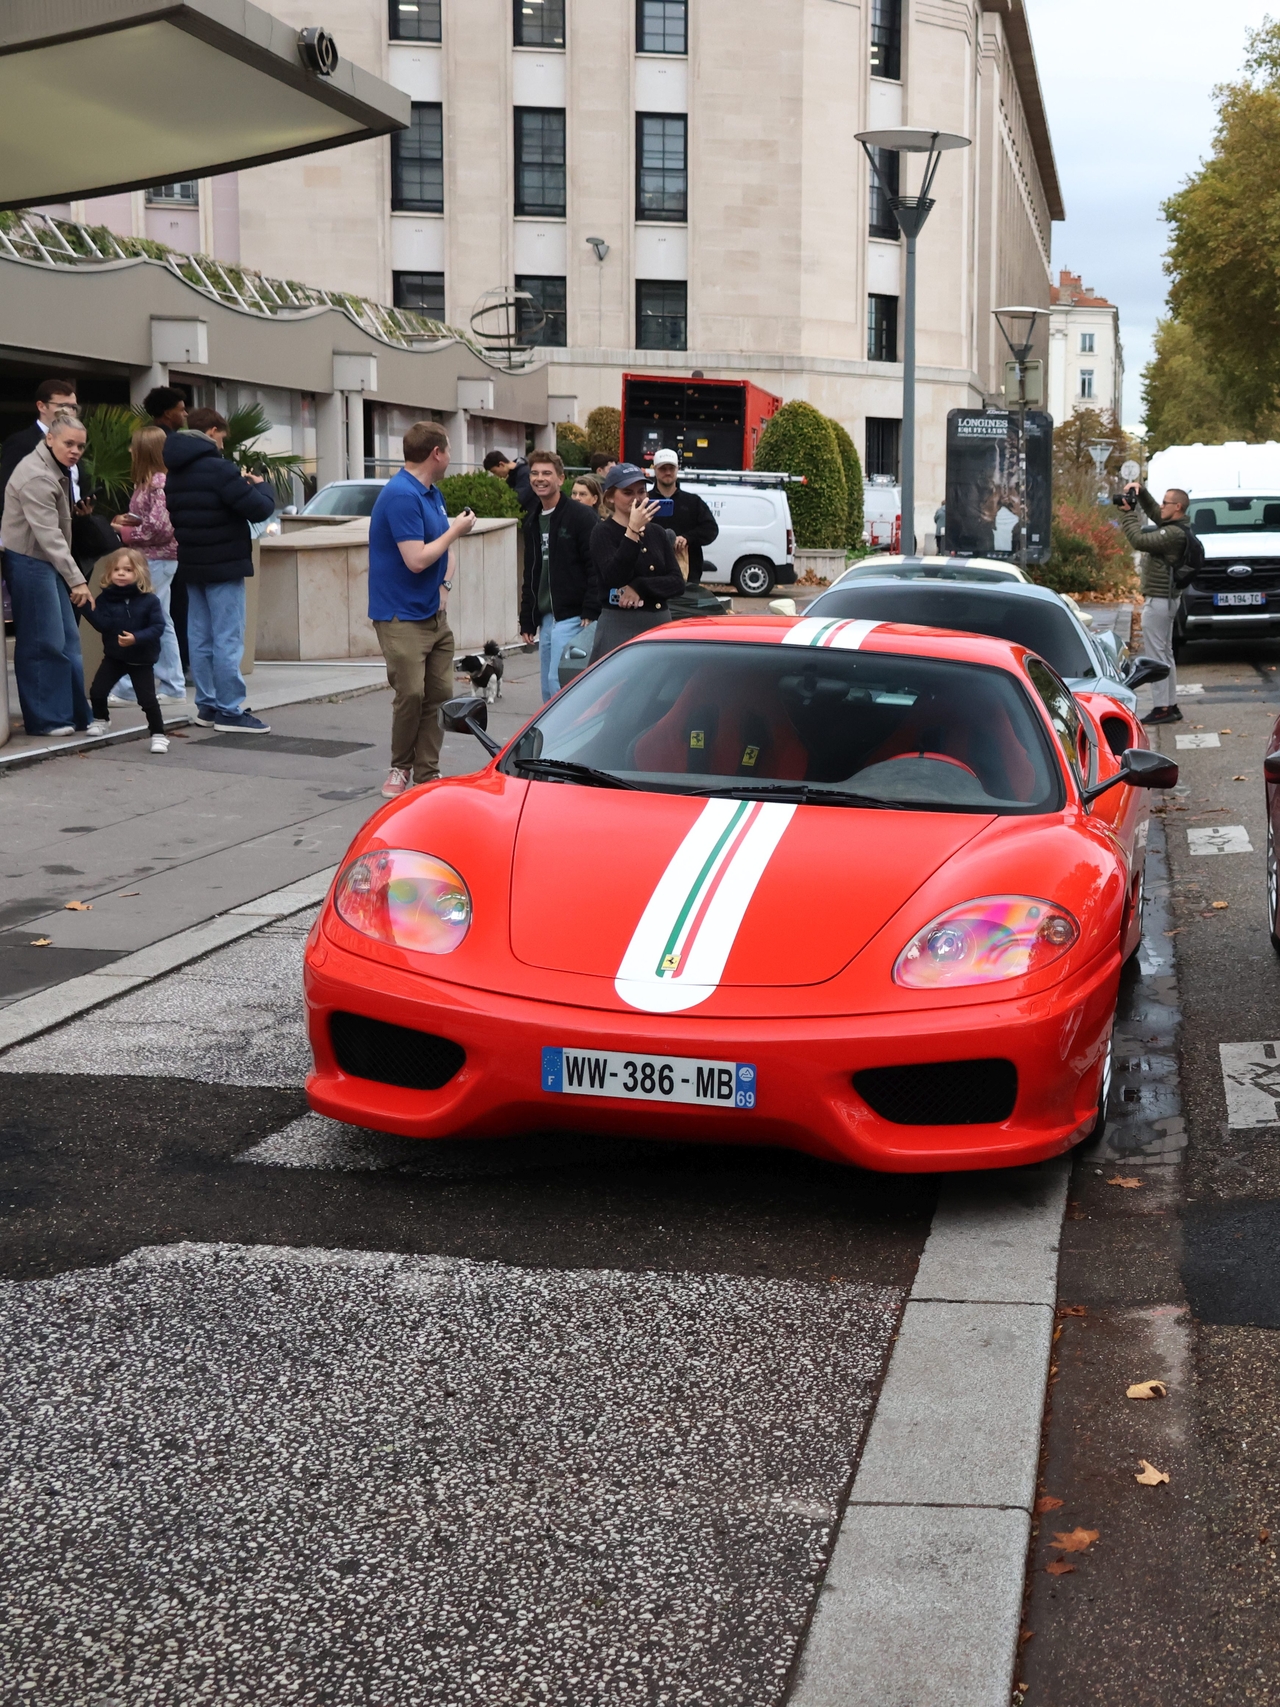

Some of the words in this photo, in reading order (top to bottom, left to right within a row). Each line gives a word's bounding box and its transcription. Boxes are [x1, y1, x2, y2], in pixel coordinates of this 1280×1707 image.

[957, 418, 1009, 428] LONGINES
[547, 1075, 556, 1086] F
[565, 1055, 734, 1100] WW-386-MB
[736, 1090, 755, 1108] 69
